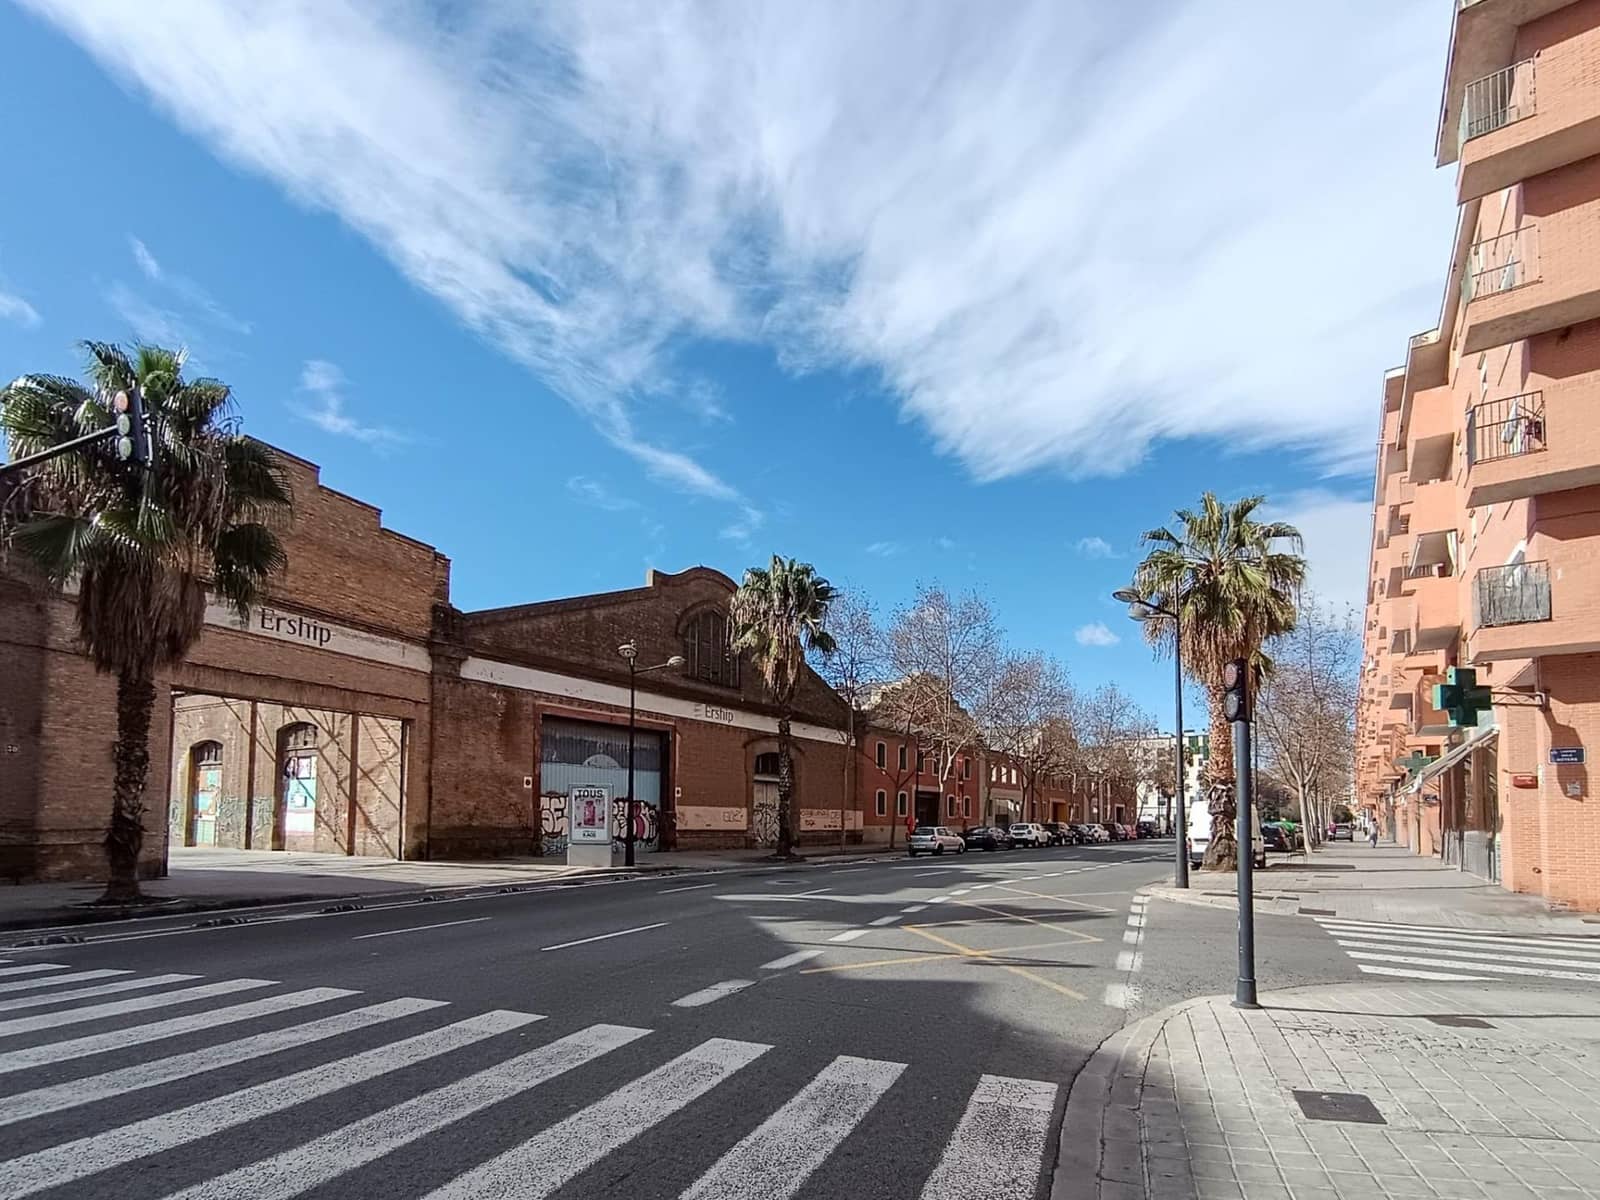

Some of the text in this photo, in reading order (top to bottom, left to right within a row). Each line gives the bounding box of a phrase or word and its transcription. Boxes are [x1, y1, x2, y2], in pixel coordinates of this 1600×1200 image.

[261, 607, 331, 646] Ership
[705, 704, 734, 723] Ership
[577, 789, 603, 798] TOUS
